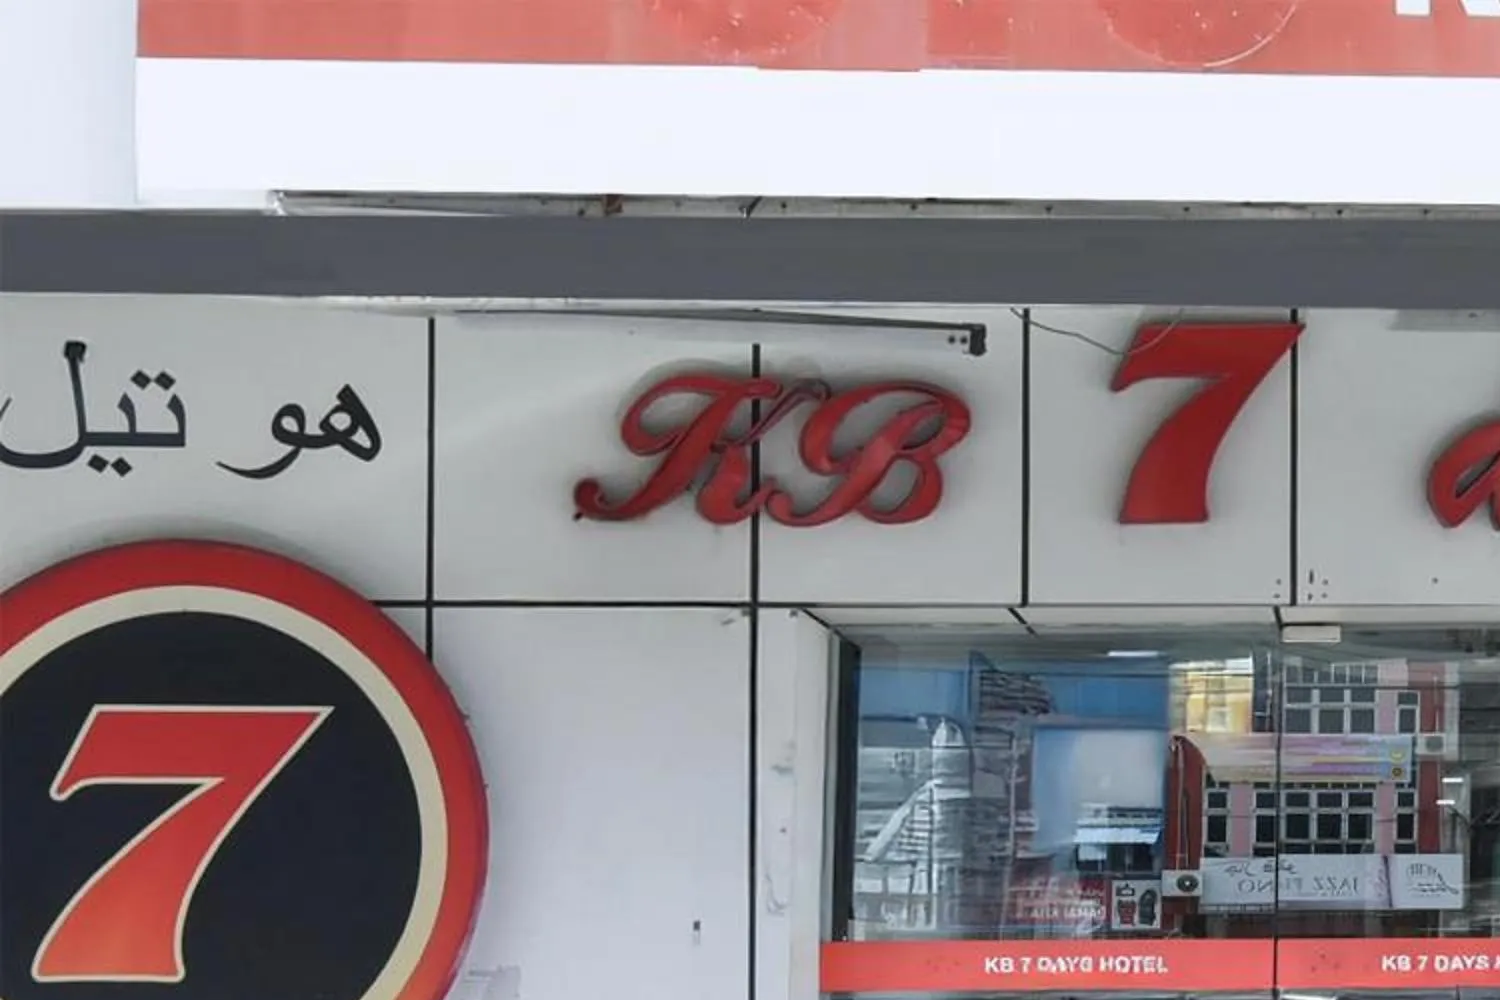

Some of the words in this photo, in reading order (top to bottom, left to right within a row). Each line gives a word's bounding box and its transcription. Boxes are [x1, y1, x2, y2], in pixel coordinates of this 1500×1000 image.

[574, 374, 971, 527] KB
[1109, 323, 1305, 524] 7
[32, 704, 335, 983] 7
[1020, 956, 1032, 973] 7
[1099, 955, 1168, 974] HOTEL
[1381, 955, 1411, 971] KB
[1417, 955, 1428, 971] 7
[1434, 955, 1490, 972] DAYS
